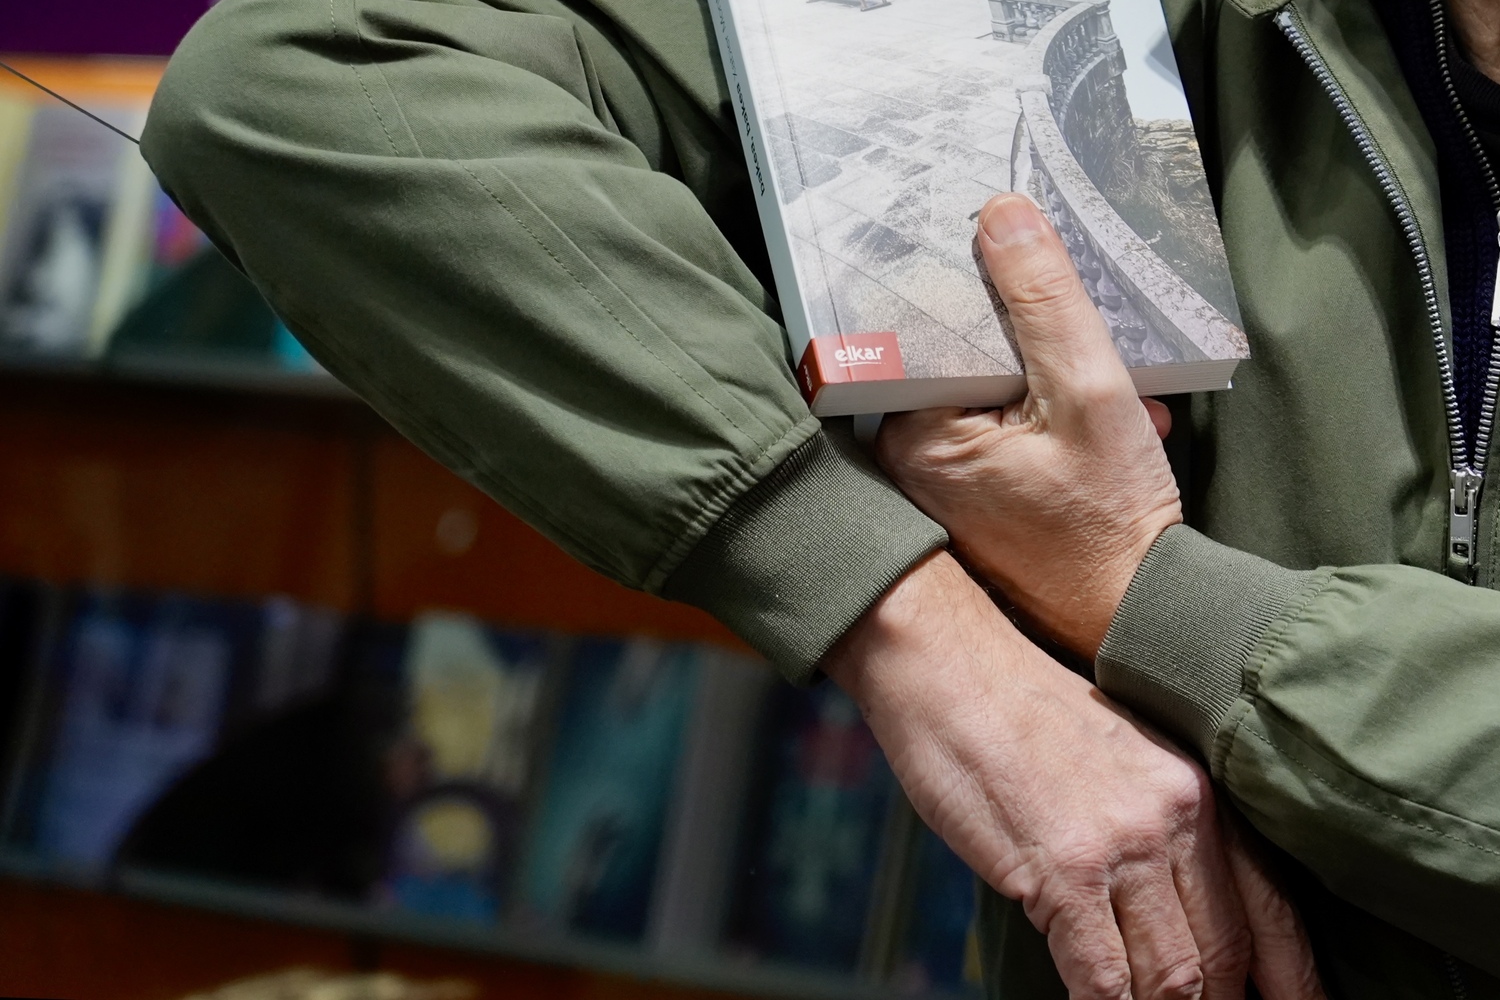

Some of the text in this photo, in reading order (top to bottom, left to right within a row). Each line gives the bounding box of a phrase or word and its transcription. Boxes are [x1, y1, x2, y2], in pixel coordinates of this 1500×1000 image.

[736, 82, 751, 137] bakea
[751, 135, 766, 197] bakea,
[835, 345, 884, 362] elkar
